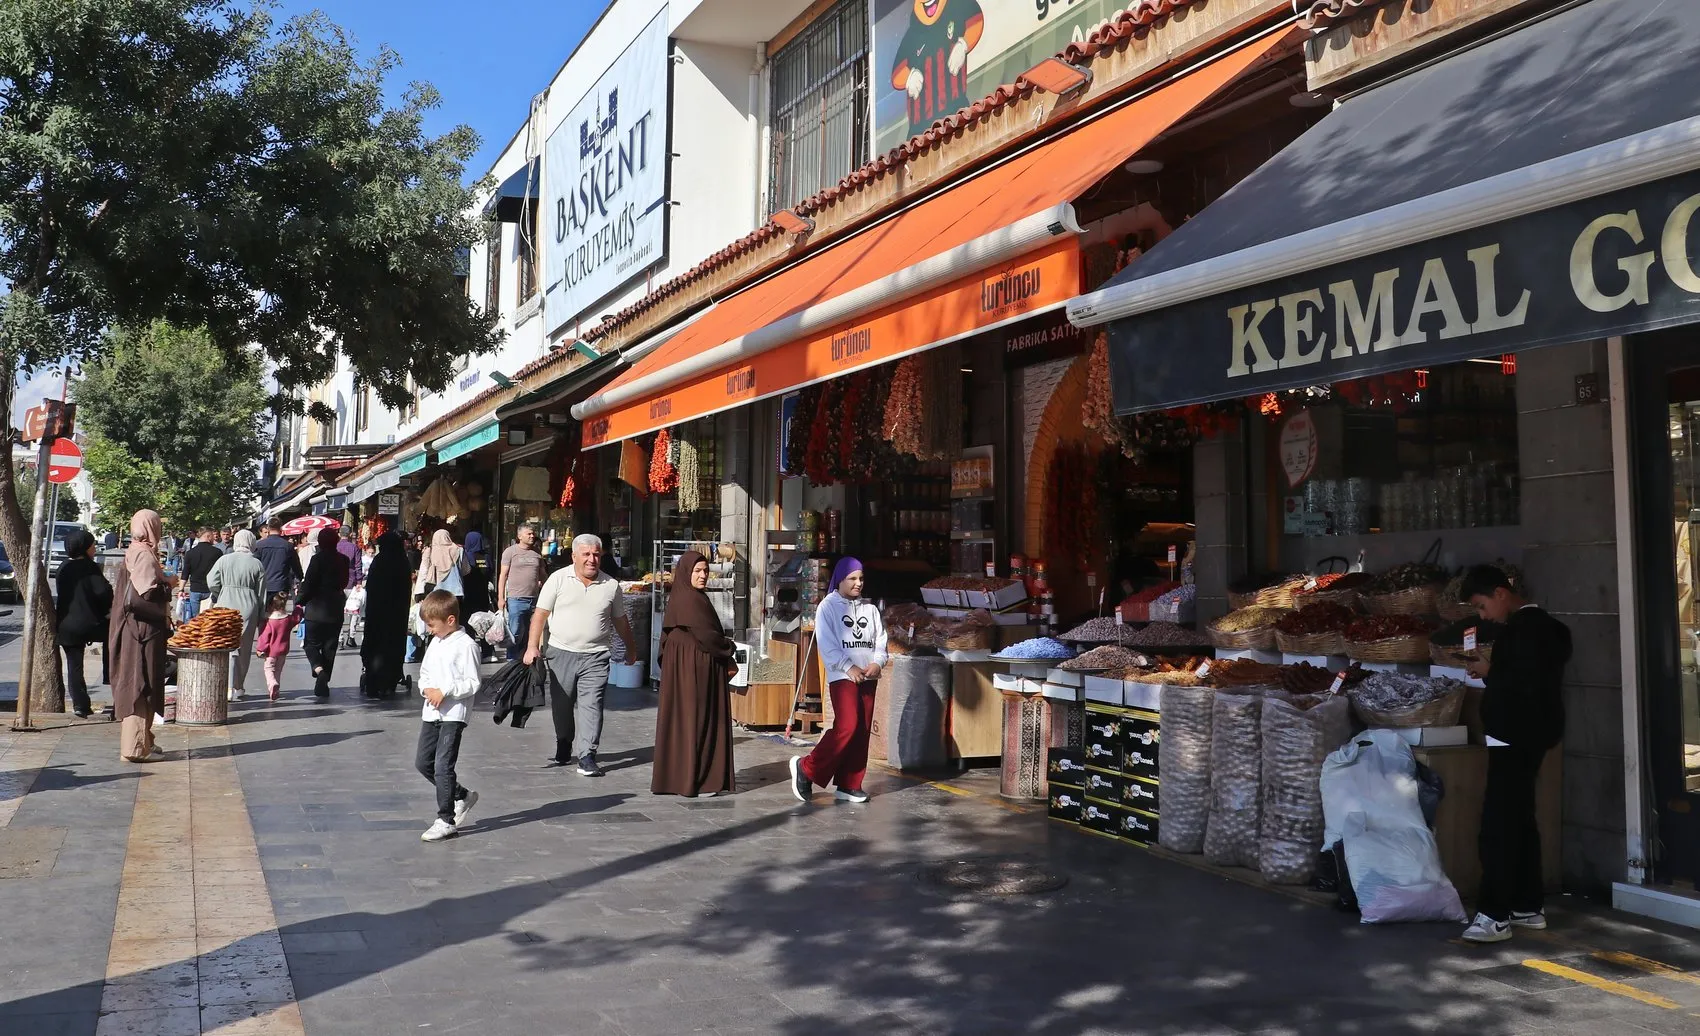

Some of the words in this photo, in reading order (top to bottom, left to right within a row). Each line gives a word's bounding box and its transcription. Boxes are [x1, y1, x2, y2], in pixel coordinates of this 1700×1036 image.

[556, 109, 651, 244] BAŞKENT
[564, 201, 635, 293] KURUYEMİŞ
[1227, 243, 1531, 378] KEMAL
[842, 639, 873, 649] hummel
